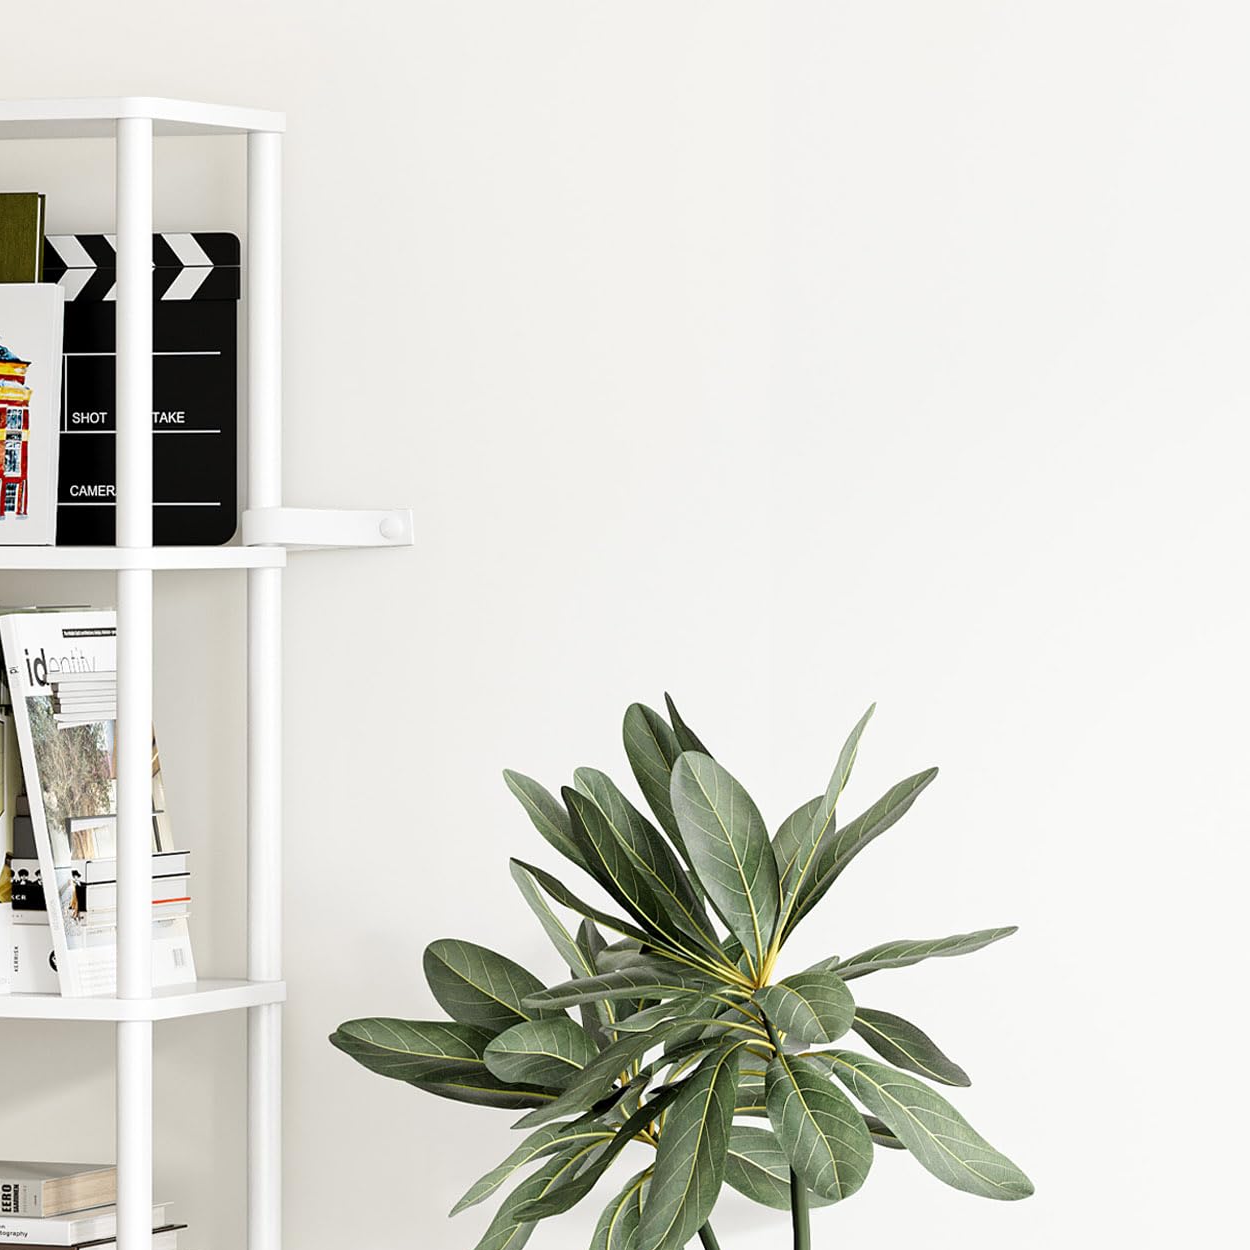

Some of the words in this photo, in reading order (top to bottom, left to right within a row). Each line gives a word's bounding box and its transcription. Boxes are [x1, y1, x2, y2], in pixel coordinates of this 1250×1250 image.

[71, 411, 108, 424] SHOT
[151, 411, 186, 424] TAKE
[69, 485, 117, 497] CAMER
[1, 1184, 12, 1213] EERO
